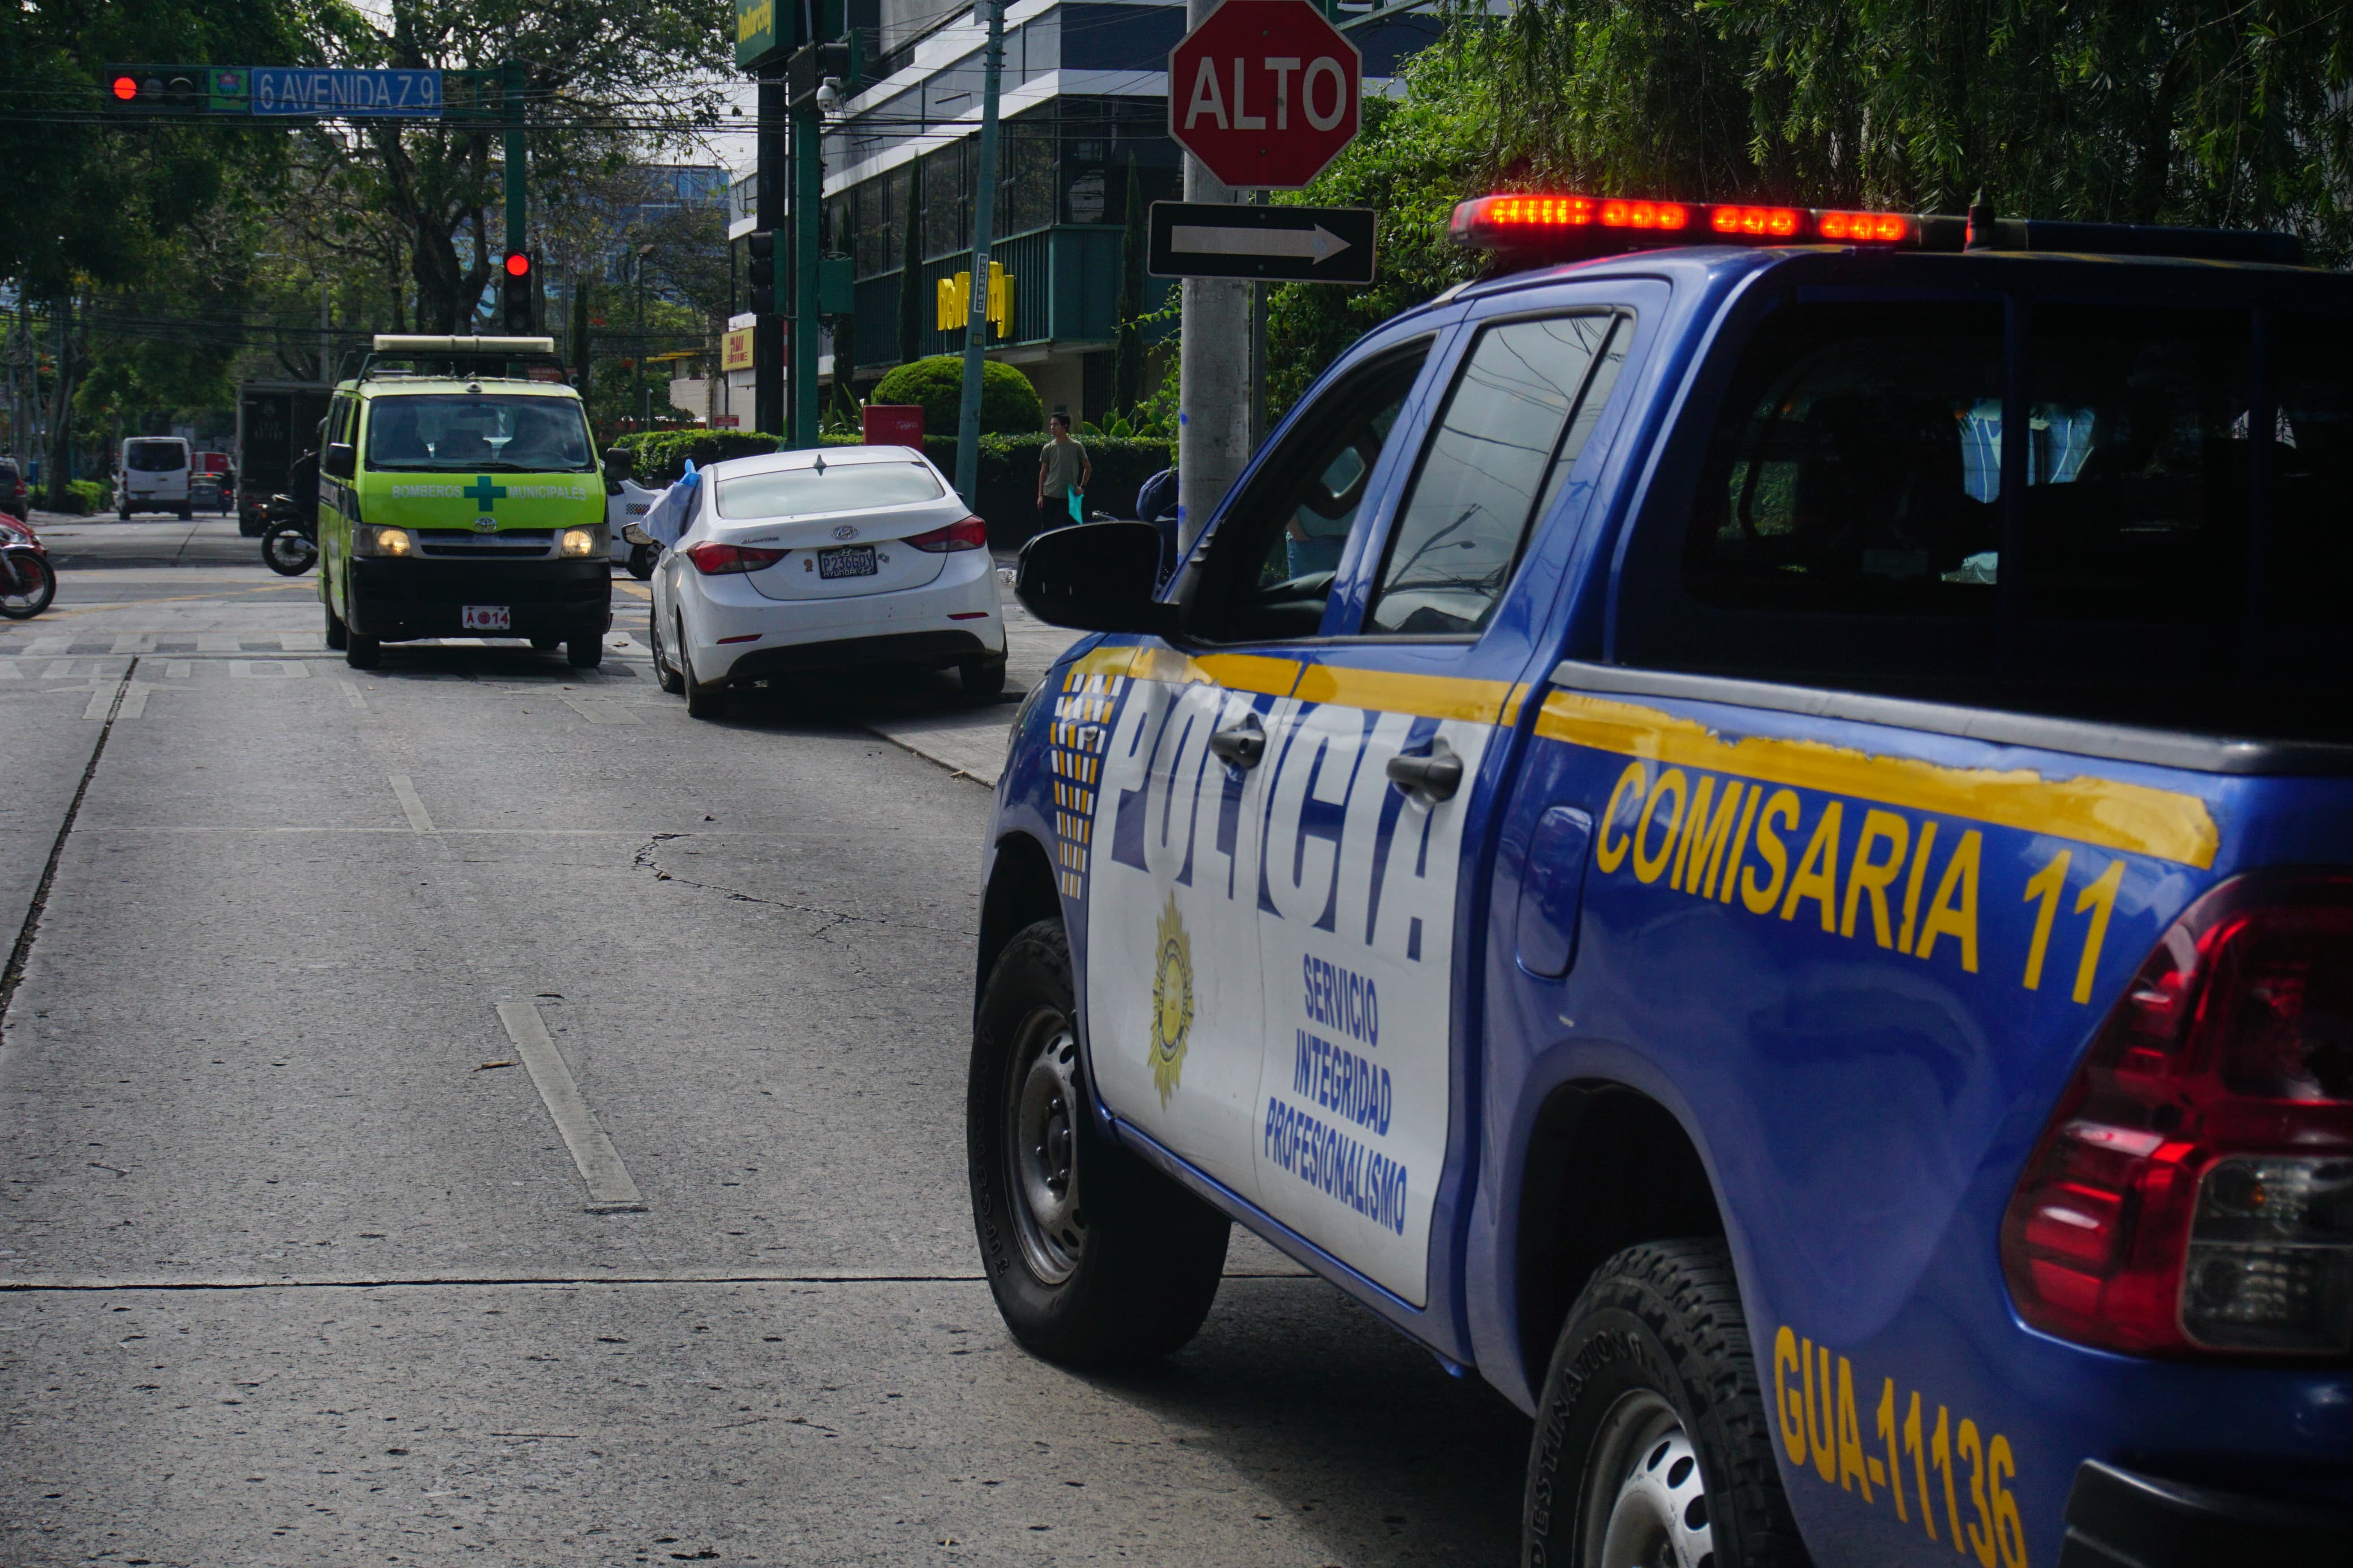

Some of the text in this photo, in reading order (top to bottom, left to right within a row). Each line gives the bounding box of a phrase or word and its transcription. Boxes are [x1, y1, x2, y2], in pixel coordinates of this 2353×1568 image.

[260, 74, 434, 111] 6 AVENIDA Z 9
[1184, 56, 1347, 132] ALTO
[391, 485, 462, 498] BOMBEROS
[508, 485, 587, 501] MUNICIPALES
[824, 568, 857, 577] HYUNDAI
[467, 611, 509, 625] A 14
[0, 658, 311, 679] LTO
[1089, 679, 1493, 964] POLICIA
[1596, 761, 2127, 1005] COMISARIA 11
[1303, 953, 1378, 1048] SERVICIO
[1293, 1028, 1393, 1138] INTEGRIDAD
[1264, 1096, 1407, 1237] PROFESIONALISMO
[1774, 1325, 2028, 1568] GUA-11136
